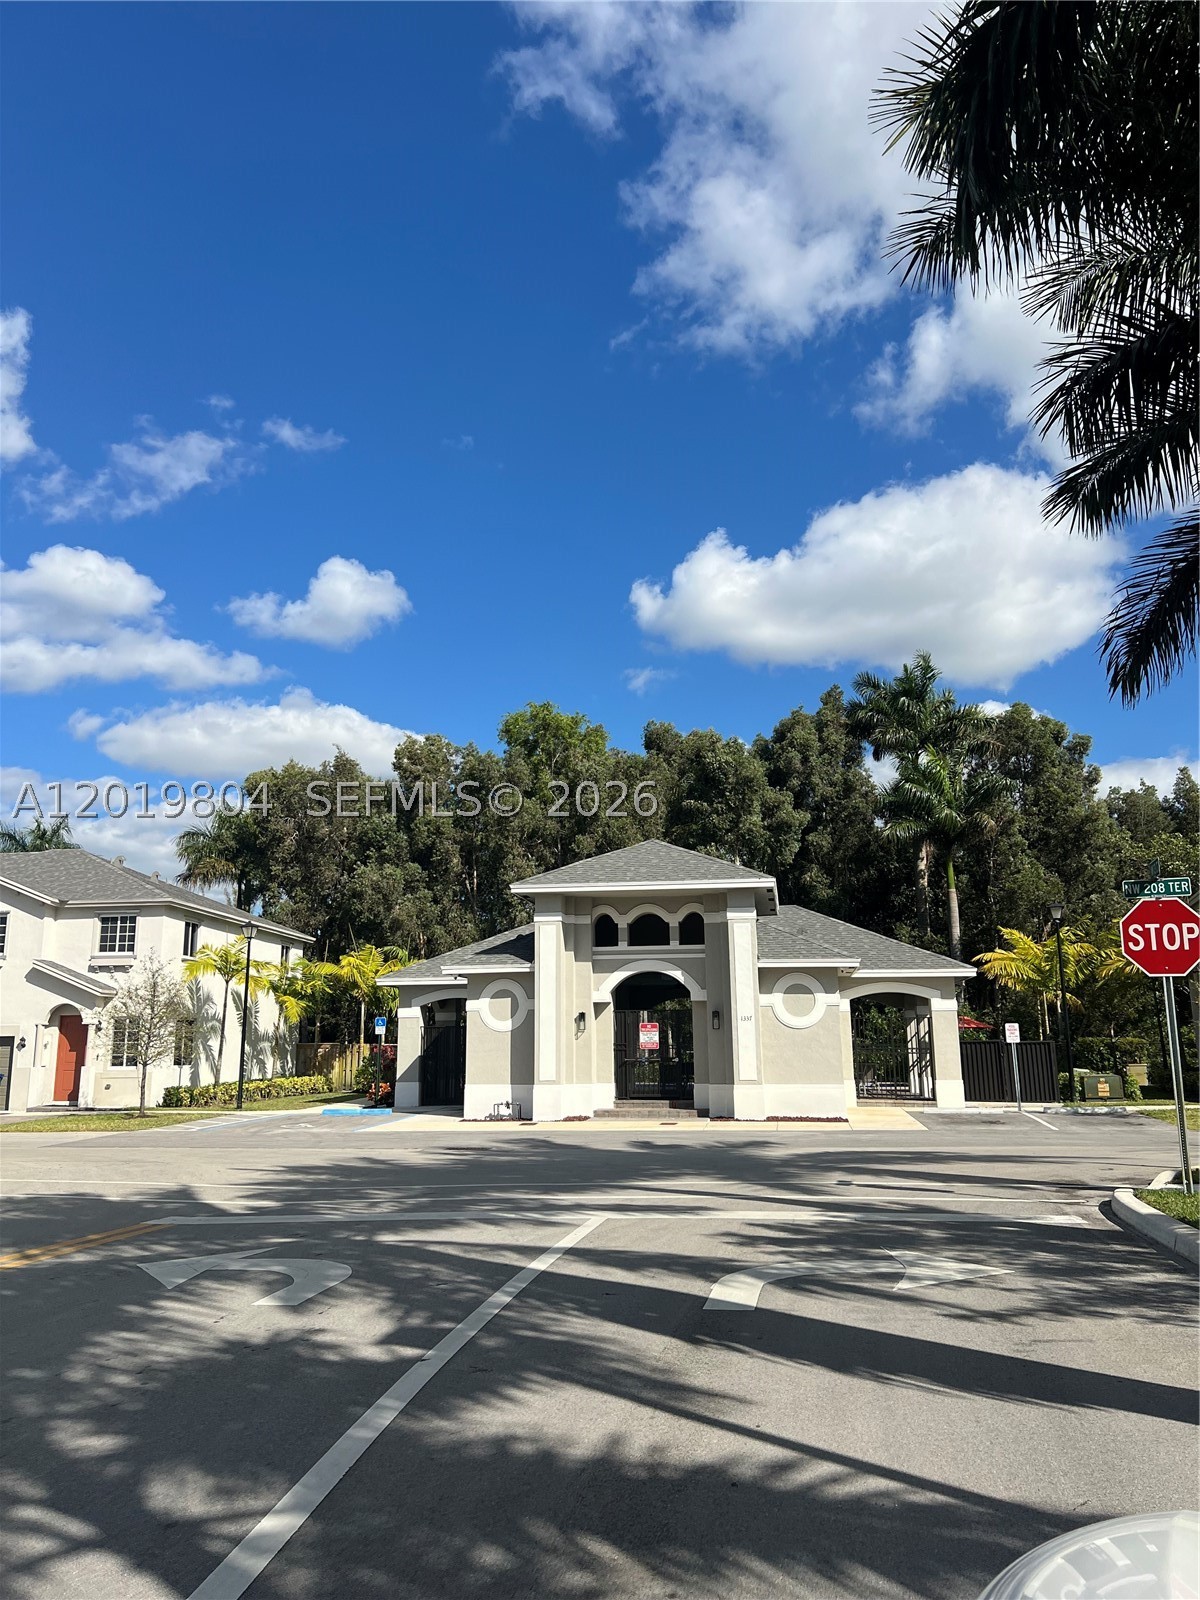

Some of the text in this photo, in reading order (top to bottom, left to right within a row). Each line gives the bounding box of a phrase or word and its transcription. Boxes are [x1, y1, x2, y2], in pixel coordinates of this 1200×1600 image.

[1125, 881, 1189, 895] NW 208 TER
[1127, 922, 1200, 952] STOP
